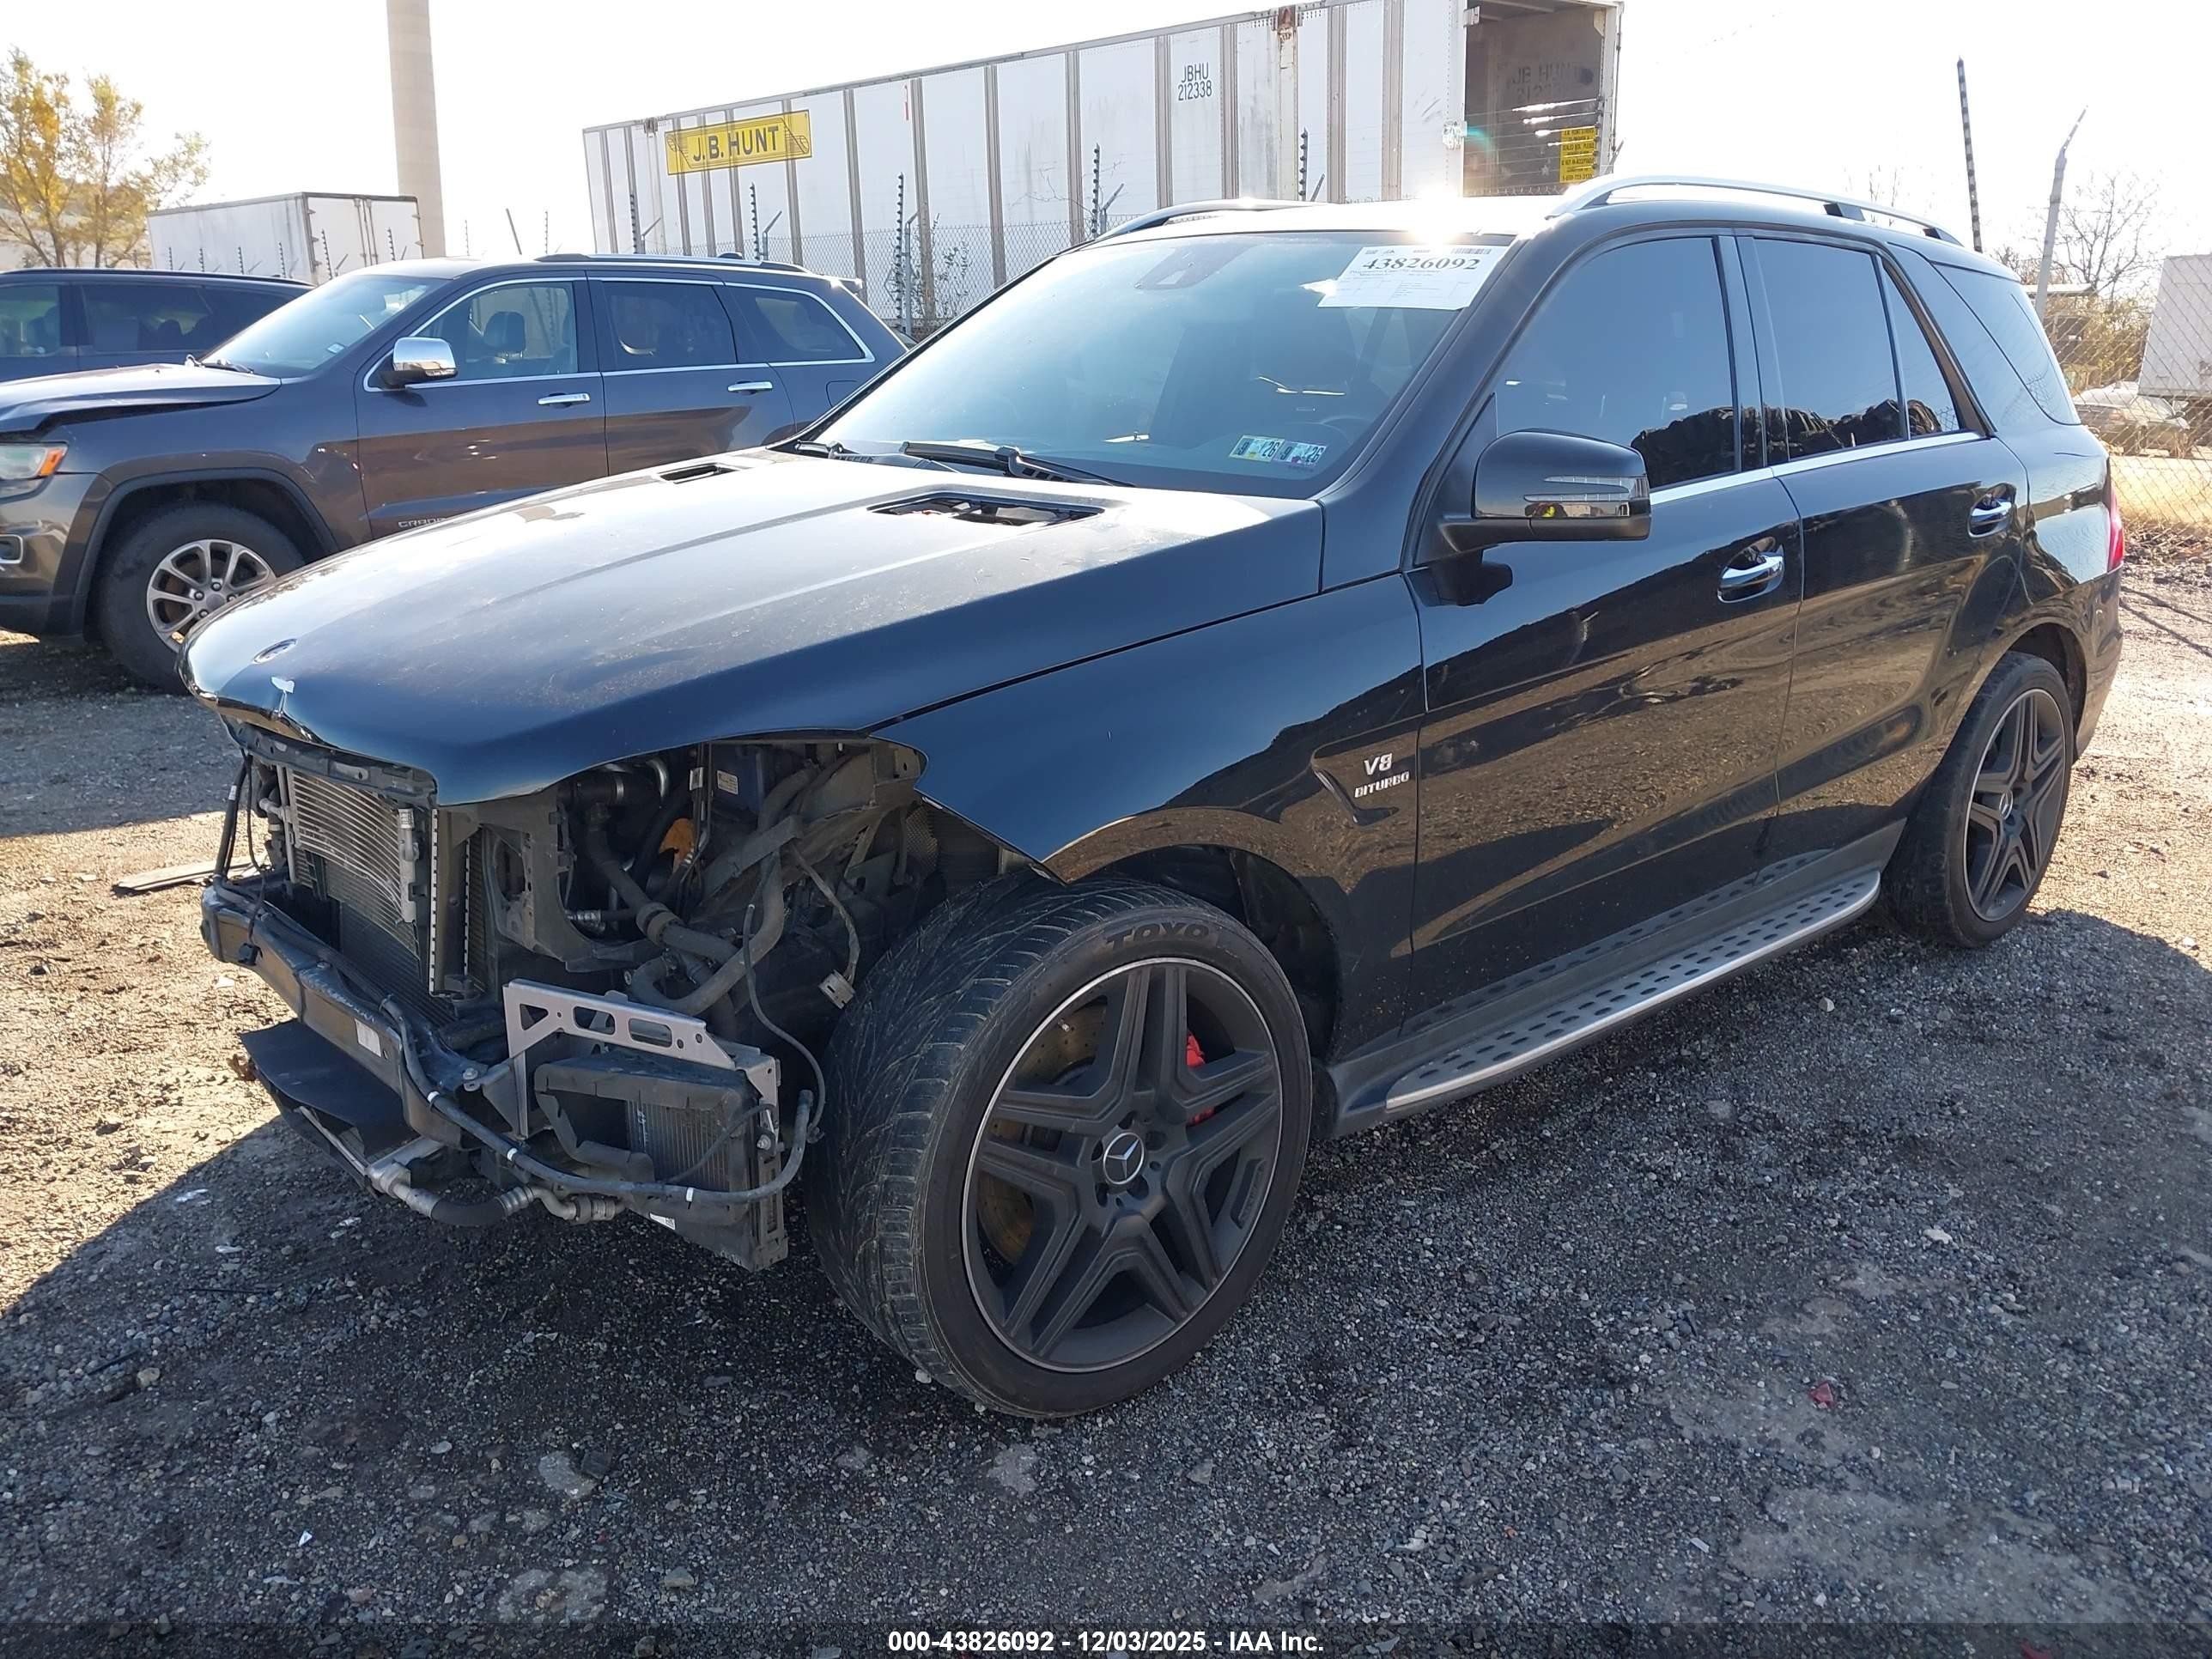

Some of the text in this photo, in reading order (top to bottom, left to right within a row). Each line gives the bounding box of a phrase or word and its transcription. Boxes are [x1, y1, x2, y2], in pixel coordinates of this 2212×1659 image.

[1181, 62, 1209, 82] JBHU
[1177, 80, 1212, 100] 212338
[693, 125, 779, 161] J.B. HUNT
[1362, 257, 1480, 270] 43826092
[1364, 752, 1393, 775] V8
[1354, 771, 1410, 799] BITURBO
[1103, 921, 1210, 950] TOYO
